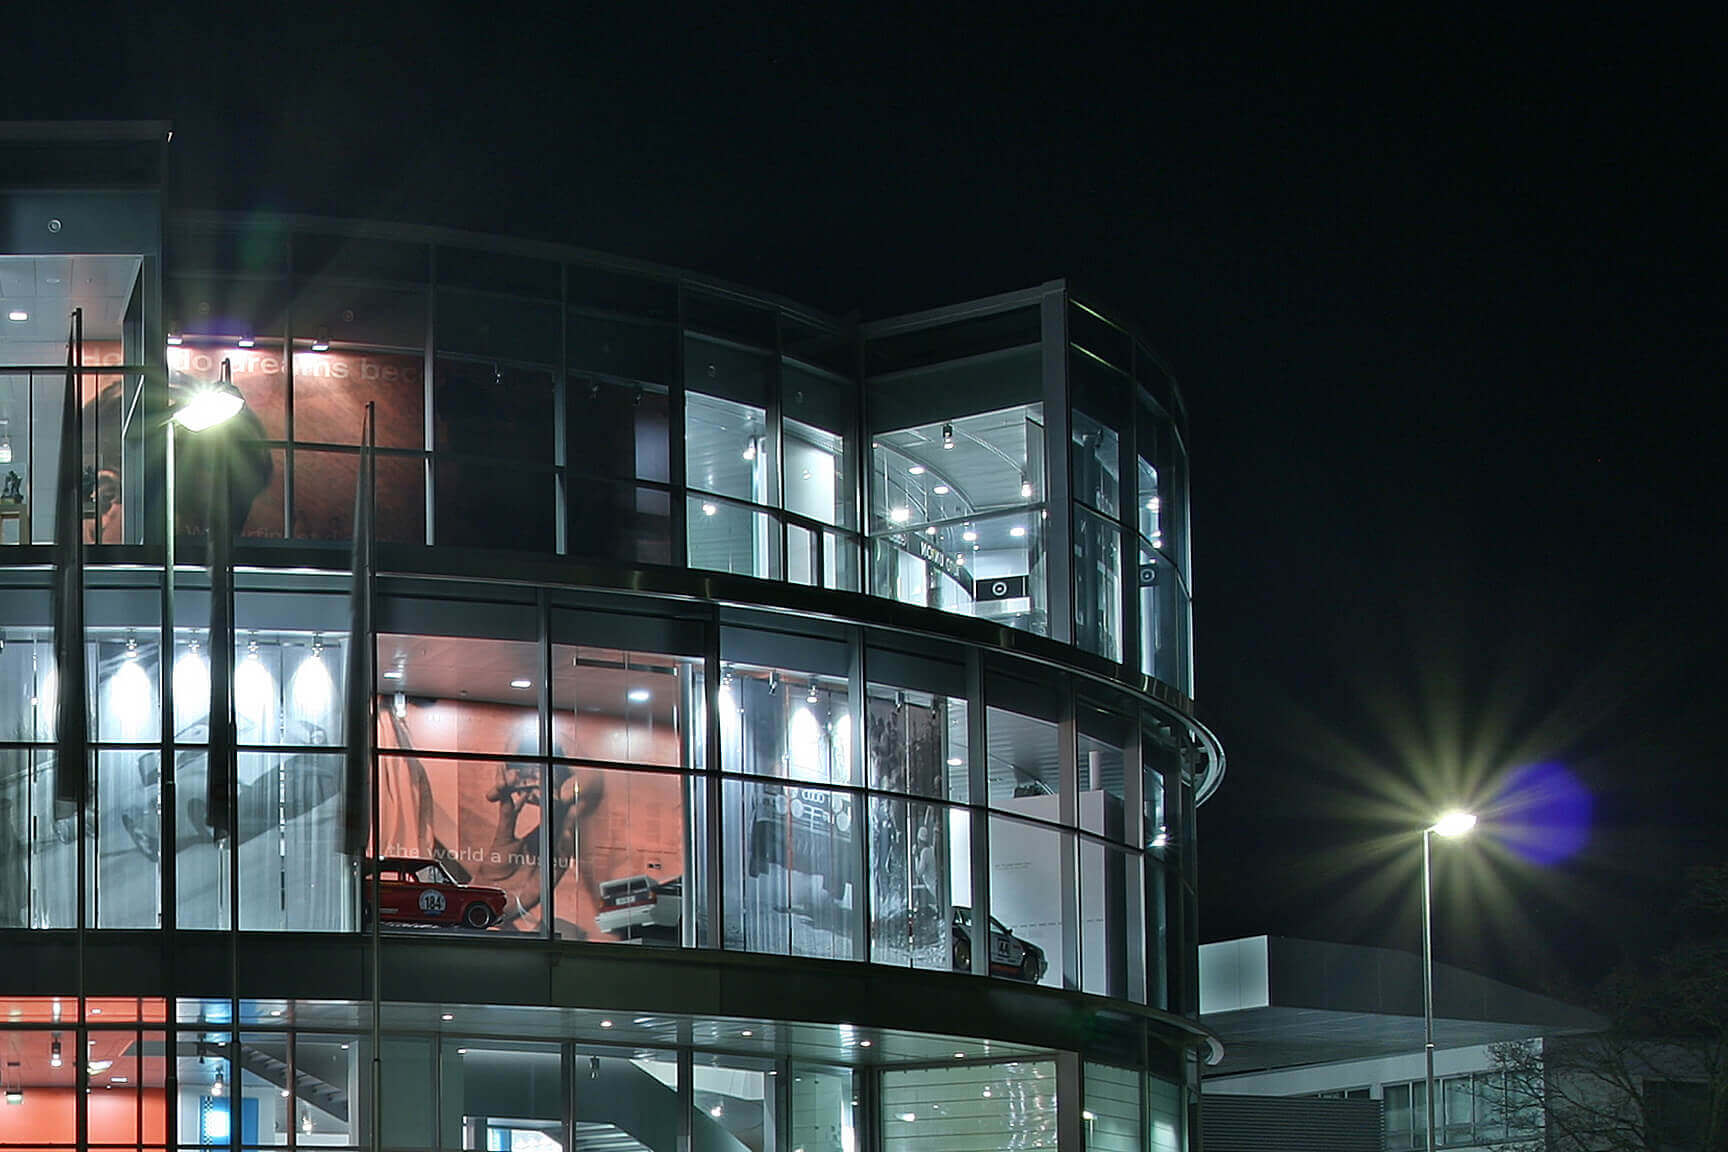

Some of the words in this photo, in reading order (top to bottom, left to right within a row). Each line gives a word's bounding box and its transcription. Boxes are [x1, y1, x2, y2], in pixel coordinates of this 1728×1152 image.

[230, 349, 349, 379] drems
[387, 842, 420, 857] the
[427, 846, 484, 863] world
[490, 851, 502, 864] a
[507, 853, 575, 869] musu
